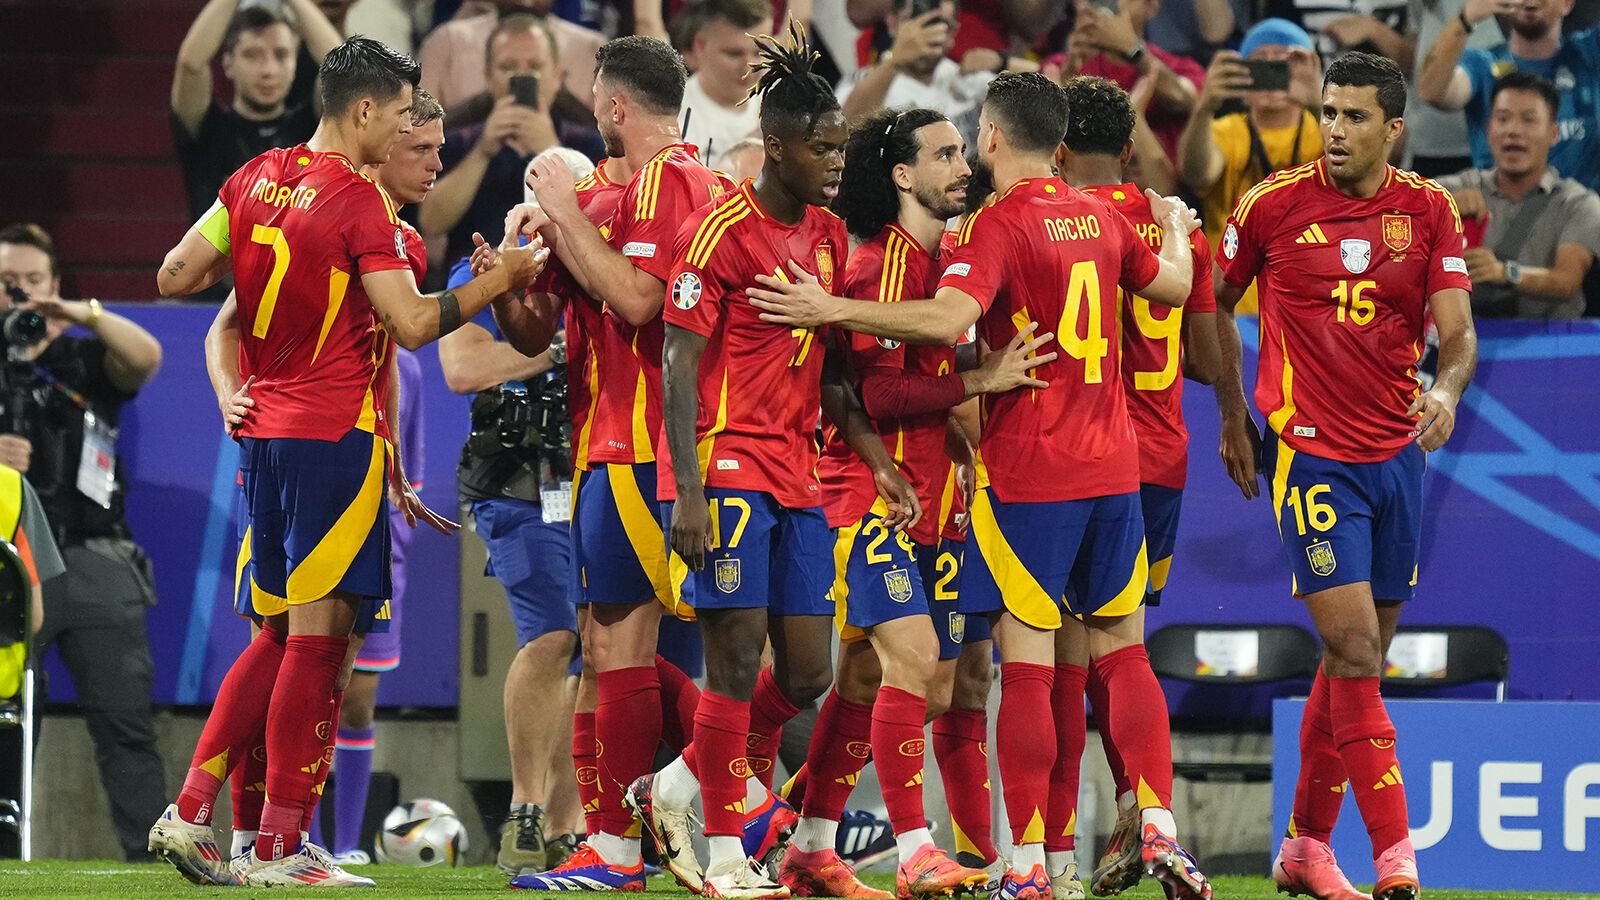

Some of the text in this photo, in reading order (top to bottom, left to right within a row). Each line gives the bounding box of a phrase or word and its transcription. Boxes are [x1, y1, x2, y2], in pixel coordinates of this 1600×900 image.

[1044, 214, 1101, 242] NACHO
[251, 223, 291, 340] 7
[1331, 280, 1377, 326] 16
[1057, 260, 1109, 384] 4
[709, 497, 752, 548] 17
[1287, 484, 1338, 536] 16
